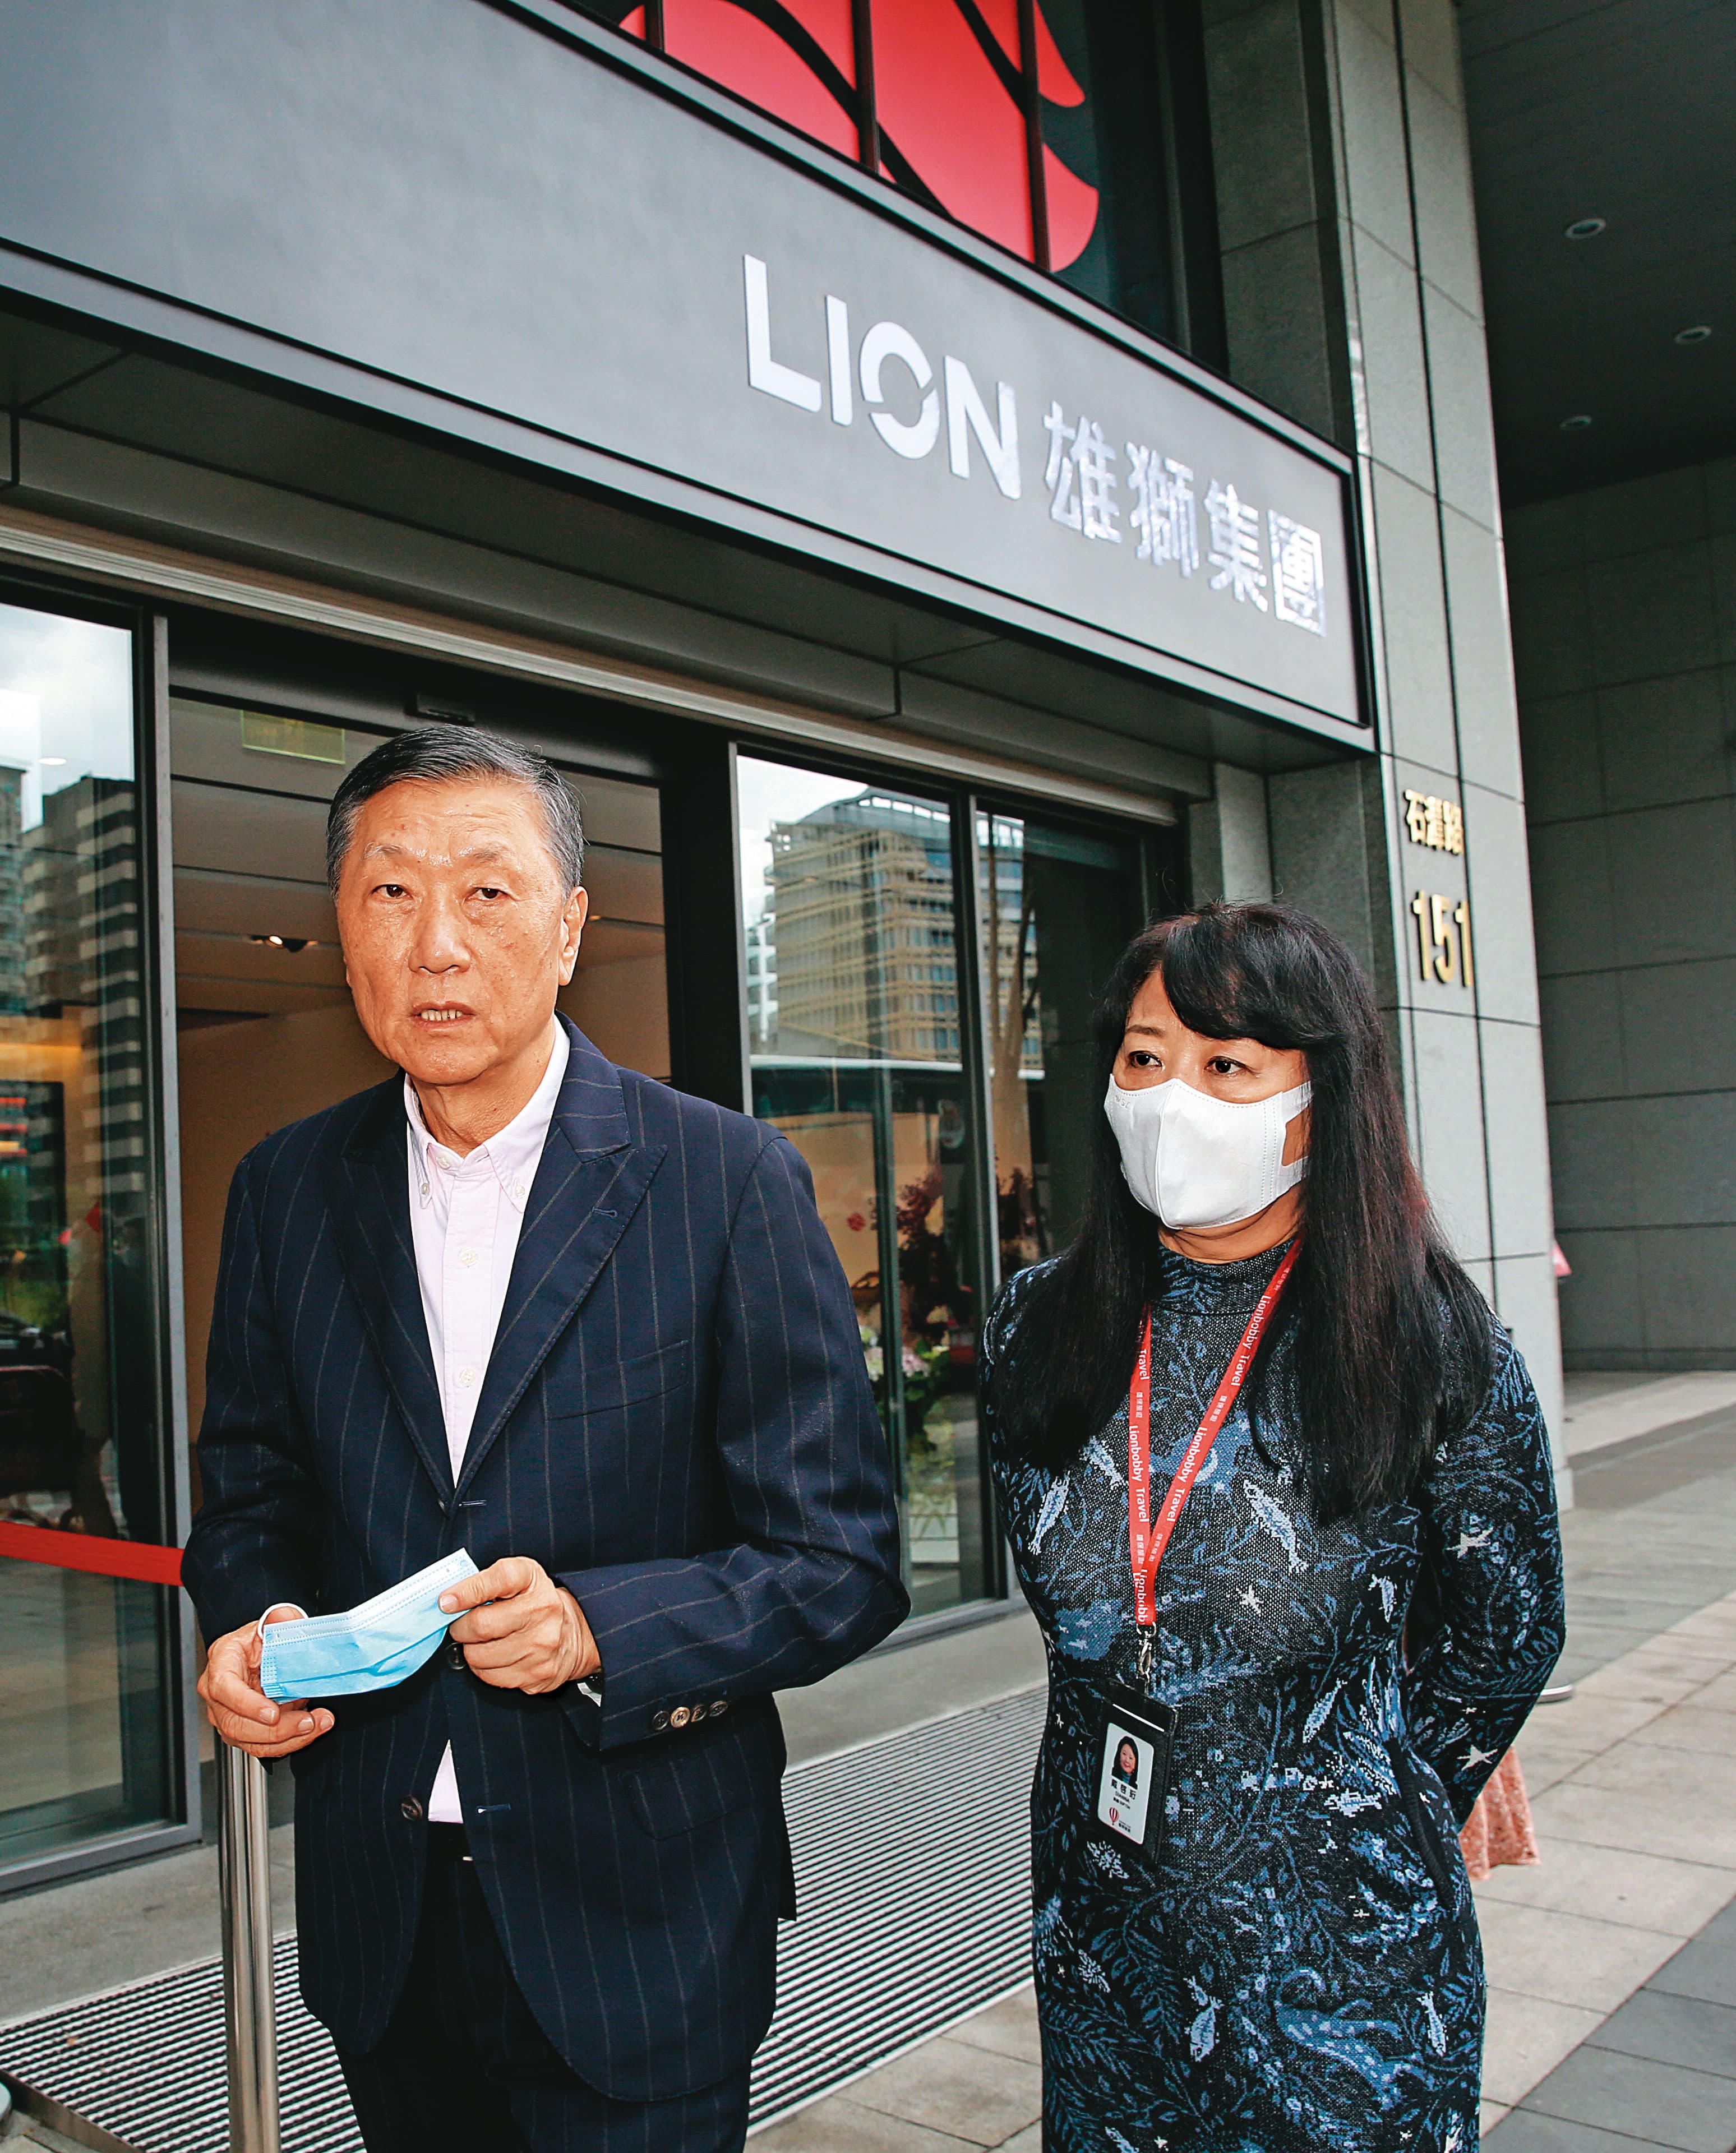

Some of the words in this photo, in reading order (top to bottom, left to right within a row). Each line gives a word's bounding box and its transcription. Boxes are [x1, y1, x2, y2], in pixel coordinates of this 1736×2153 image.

[744, 255, 1020, 499] LION
[1043, 400, 1326, 636] 雄獅集團
[1412, 890, 1474, 987] 151
[1241, 1295, 1272, 1350] Lionbobby
[1138, 1348, 1149, 1380] Travel
[1231, 1355, 1250, 1387] Travel
[1129, 1425, 1143, 1481] Lionbobby
[1178, 1427, 1207, 1482] Lionbobby
[1135, 1487, 1149, 1522] Travel
[1167, 1489, 1184, 1522] Travel
[1137, 1569, 1148, 1624] Lionbobb
